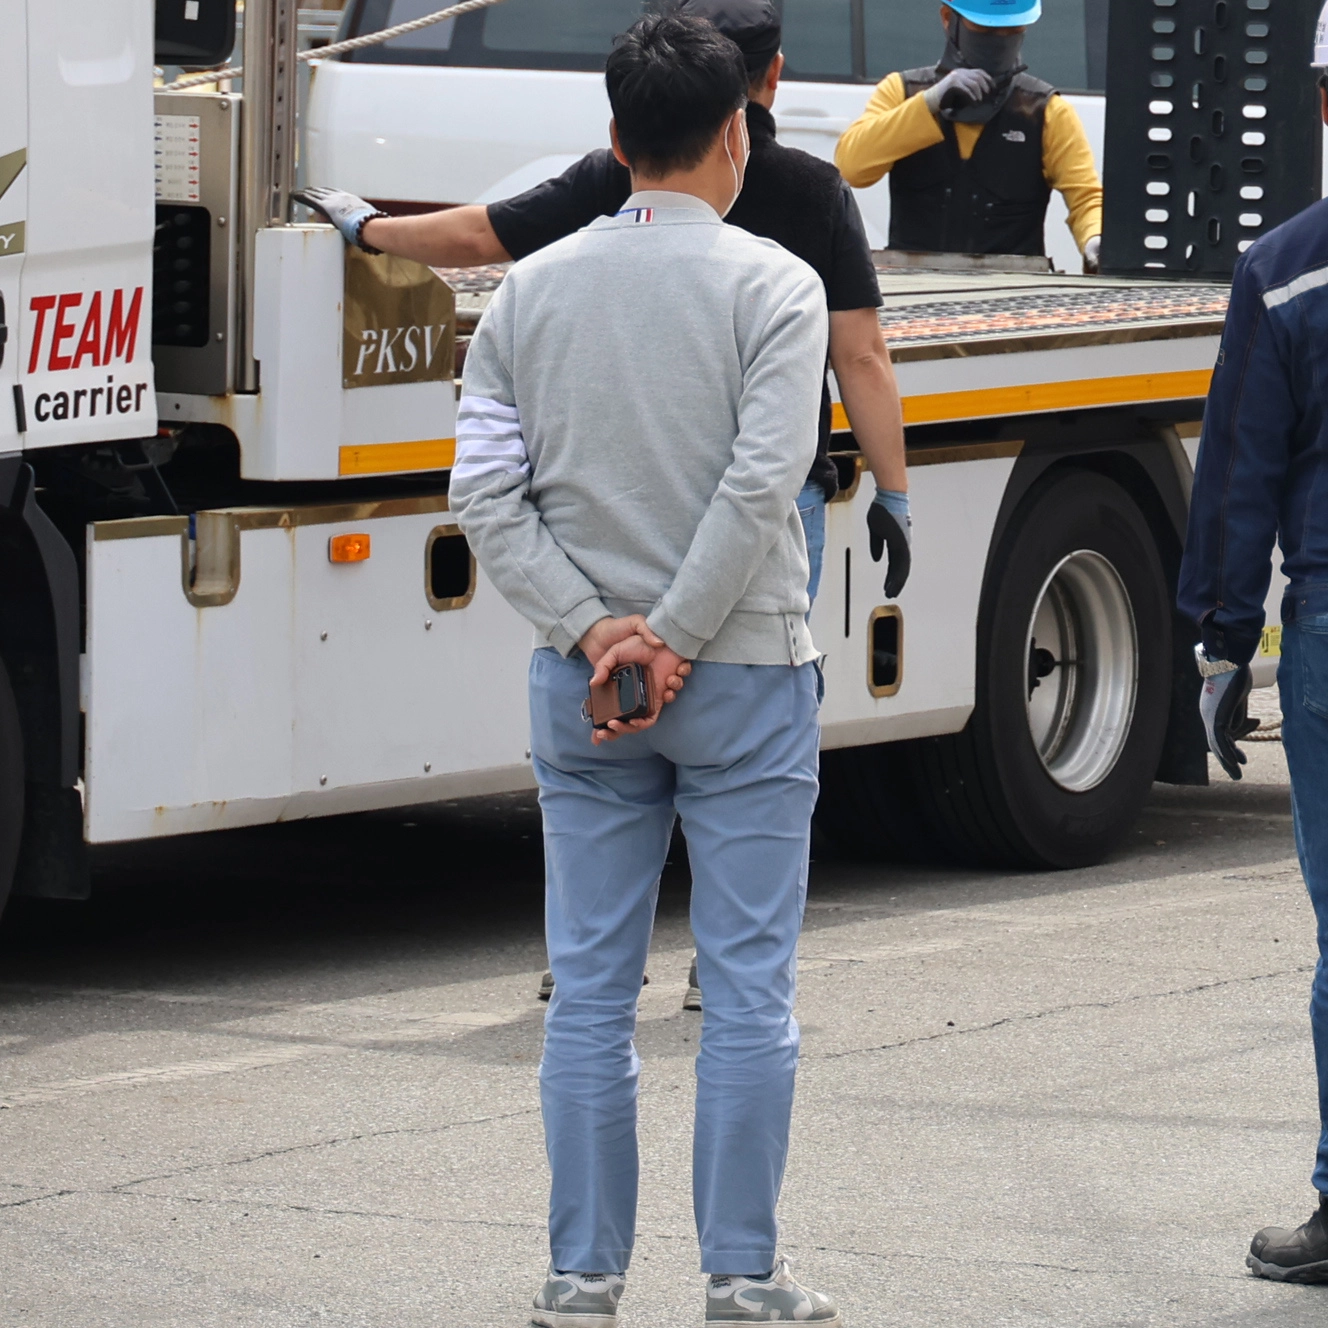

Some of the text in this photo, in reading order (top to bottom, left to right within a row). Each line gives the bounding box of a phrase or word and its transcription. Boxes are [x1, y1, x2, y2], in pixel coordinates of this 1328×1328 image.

[27, 286, 144, 374] TEAM
[353, 324, 446, 375] PKSV
[34, 375, 148, 422] carrier
